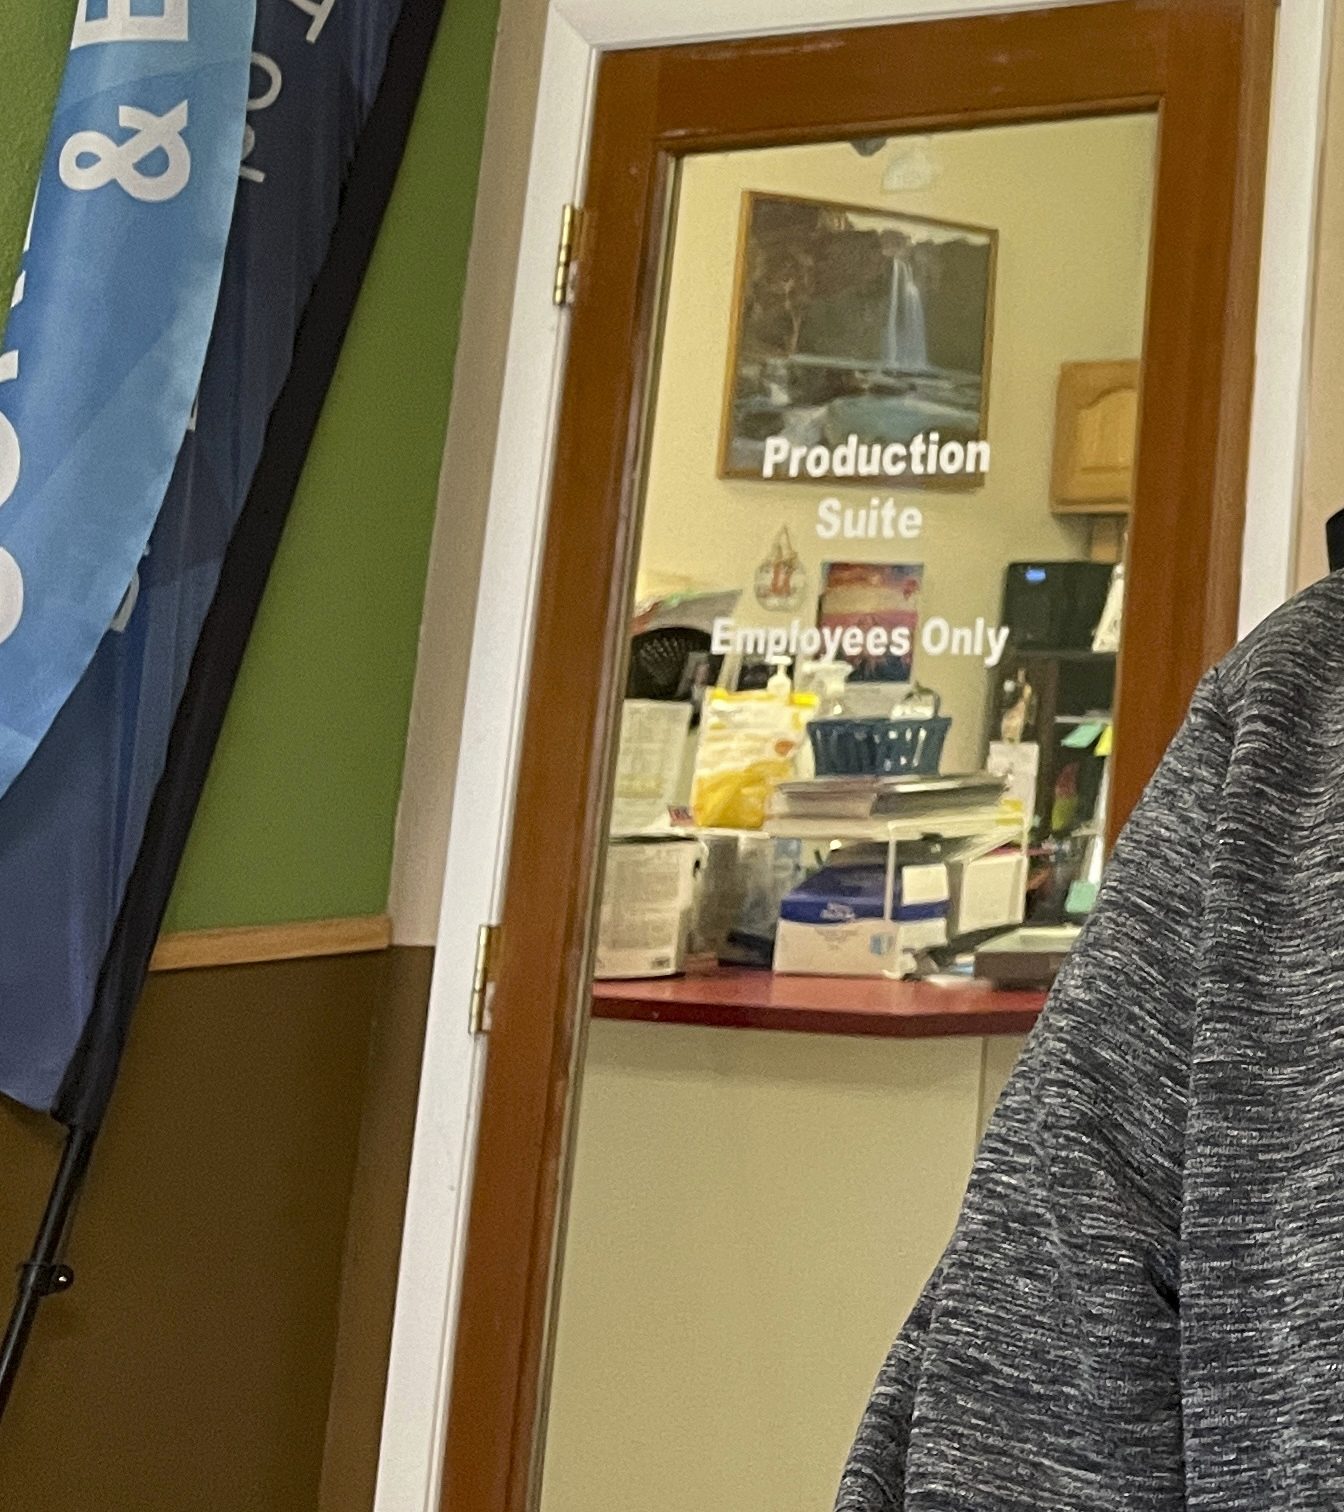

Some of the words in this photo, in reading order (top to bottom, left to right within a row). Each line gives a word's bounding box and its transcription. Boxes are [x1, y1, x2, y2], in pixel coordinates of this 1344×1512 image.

[761, 432, 992, 480] Production
[814, 497, 923, 540] Suite
[709, 618, 912, 659] Employees
[920, 617, 1010, 667] Only
